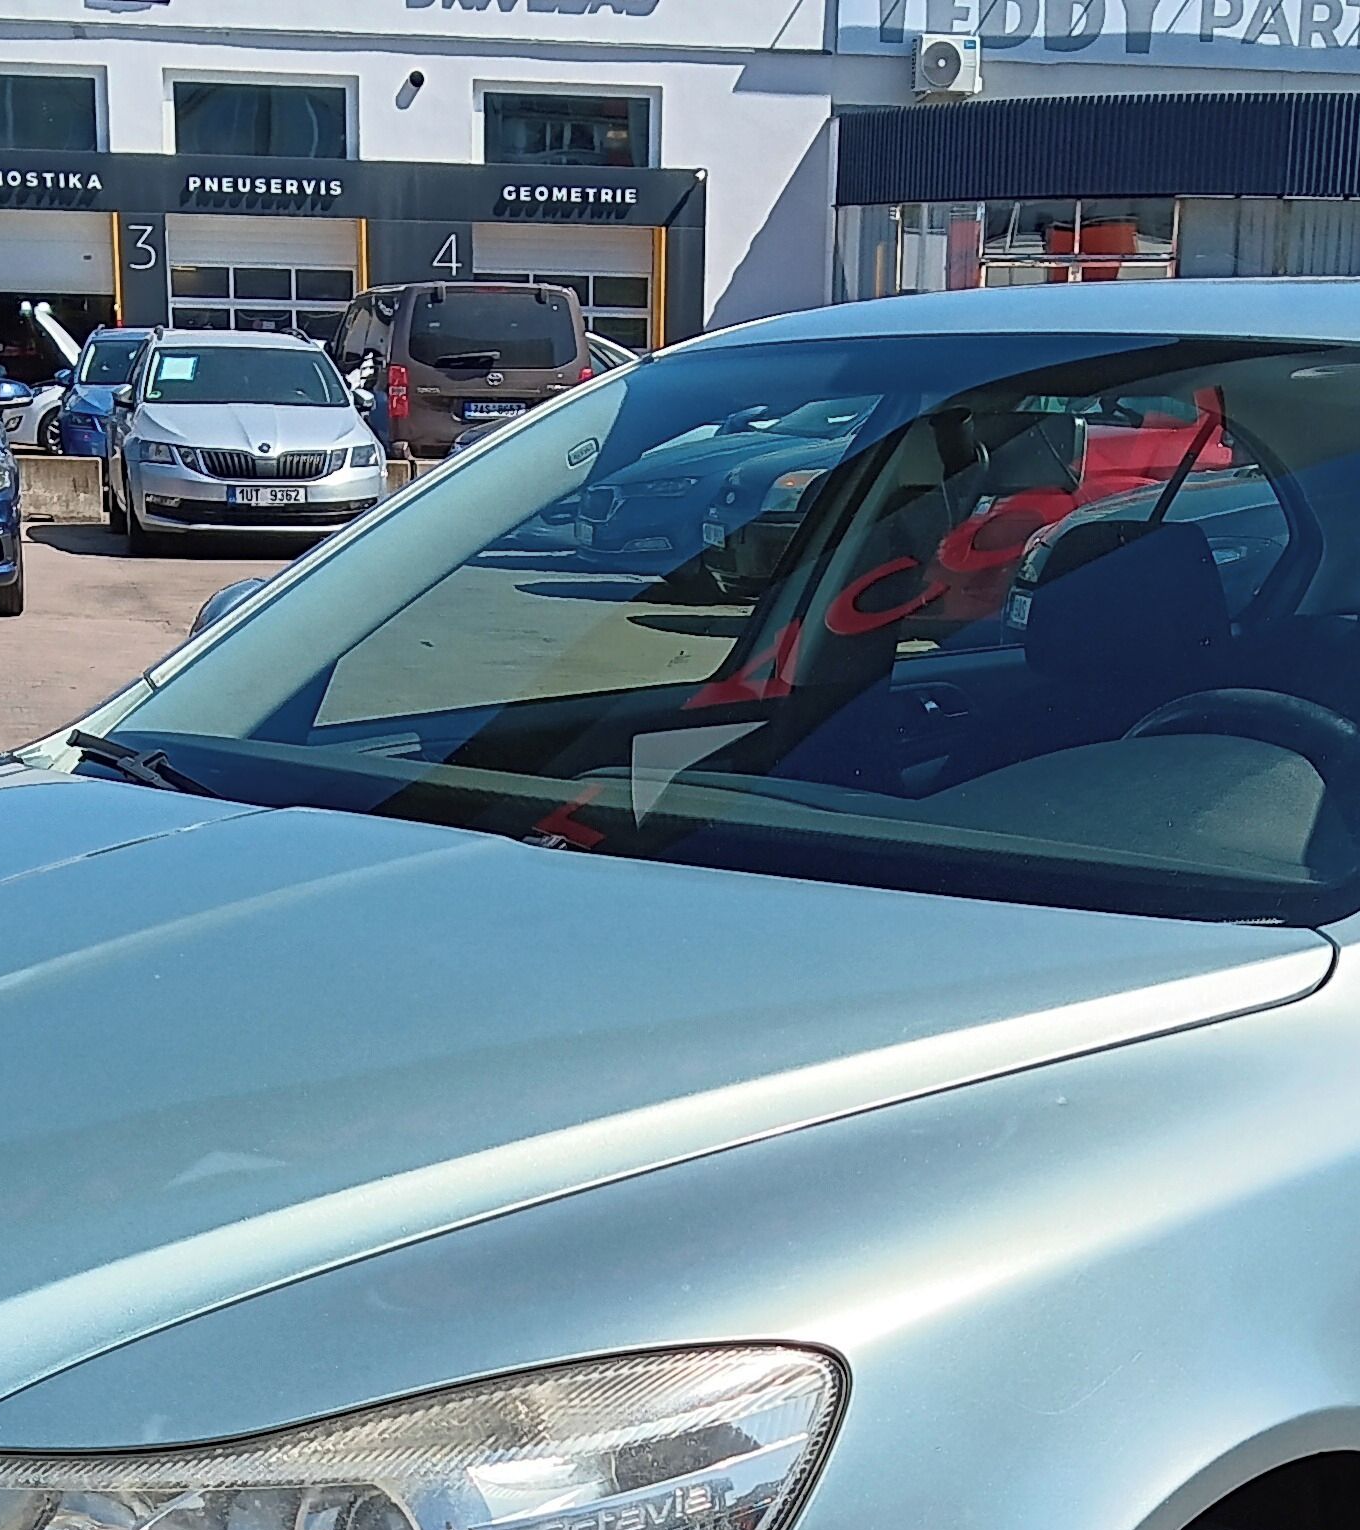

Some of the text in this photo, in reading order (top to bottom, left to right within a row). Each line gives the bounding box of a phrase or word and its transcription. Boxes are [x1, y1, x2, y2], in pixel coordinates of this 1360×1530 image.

[188, 176, 342, 196] PNEUSERVIS
[503, 185, 637, 204] GEOMETRIE
[128, 225, 156, 269] 3
[432, 233, 462, 276] 4
[238, 488, 300, 502] 1UT 9362
